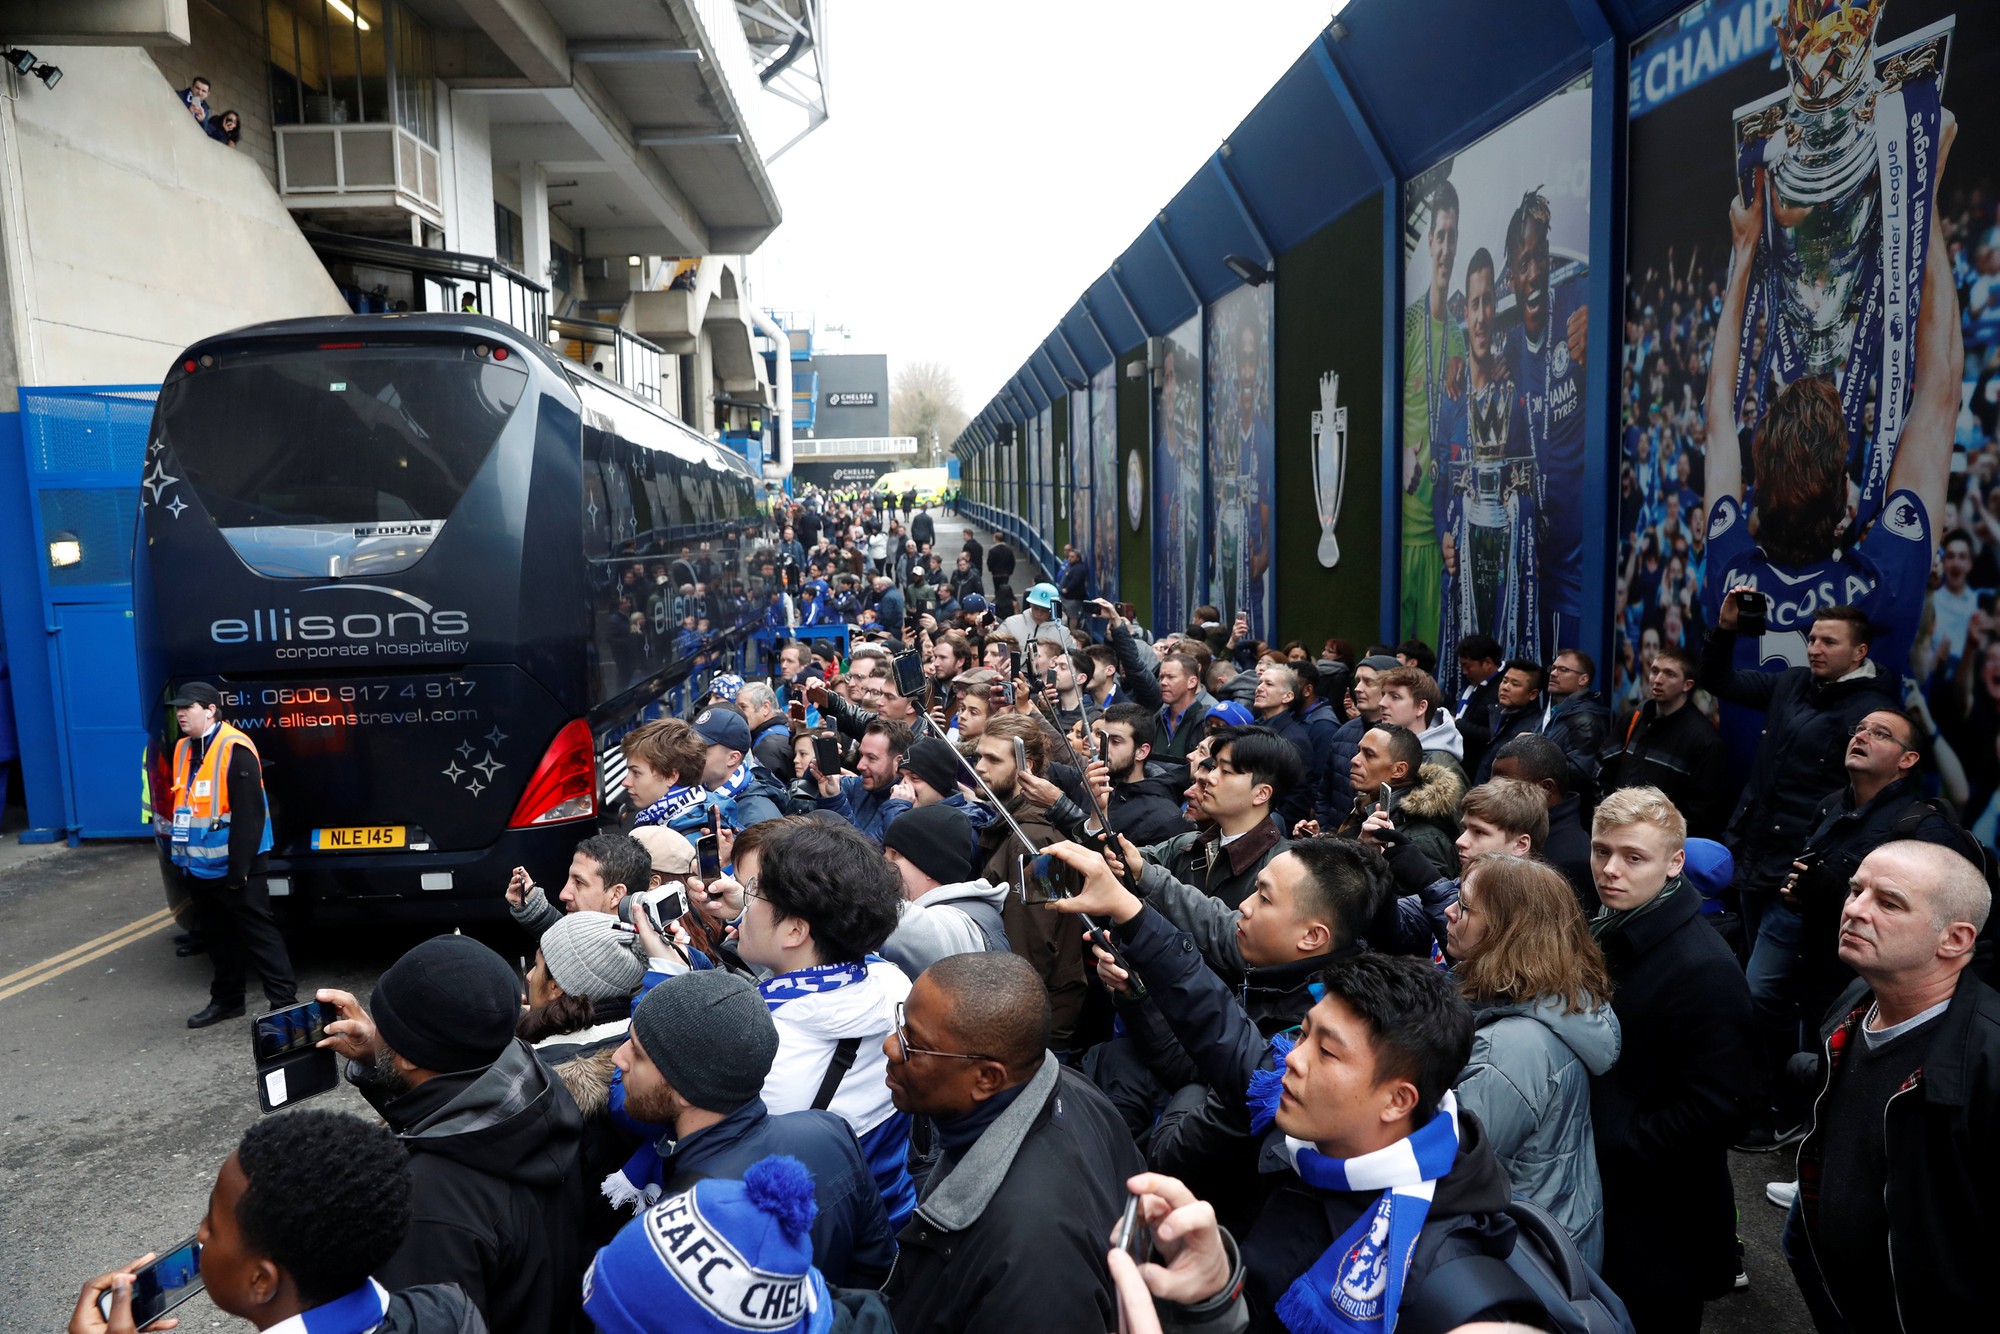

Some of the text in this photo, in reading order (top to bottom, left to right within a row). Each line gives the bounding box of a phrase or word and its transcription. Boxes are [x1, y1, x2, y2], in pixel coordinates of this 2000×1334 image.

[1909, 111, 1931, 282] Premier League
[1888, 140, 1904, 305] Premier League
[1741, 283, 1760, 348] League
[1842, 354, 1861, 415] remier
[1854, 274, 1881, 350] League
[1553, 396, 1578, 423] TYRES
[1884, 349, 1903, 432] League
[843, 468, 876, 476] CHELSEA
[354, 525, 432, 538] NEOPLAN
[1525, 517, 1535, 636] Premier League
[210, 607, 470, 644] ellisons
[654, 587, 707, 635] ellisons
[276, 639, 470, 660] corporate hospitality
[219, 681, 477, 707] Tel: 0800 917 4 917
[331, 829, 393, 845] NLE 145
